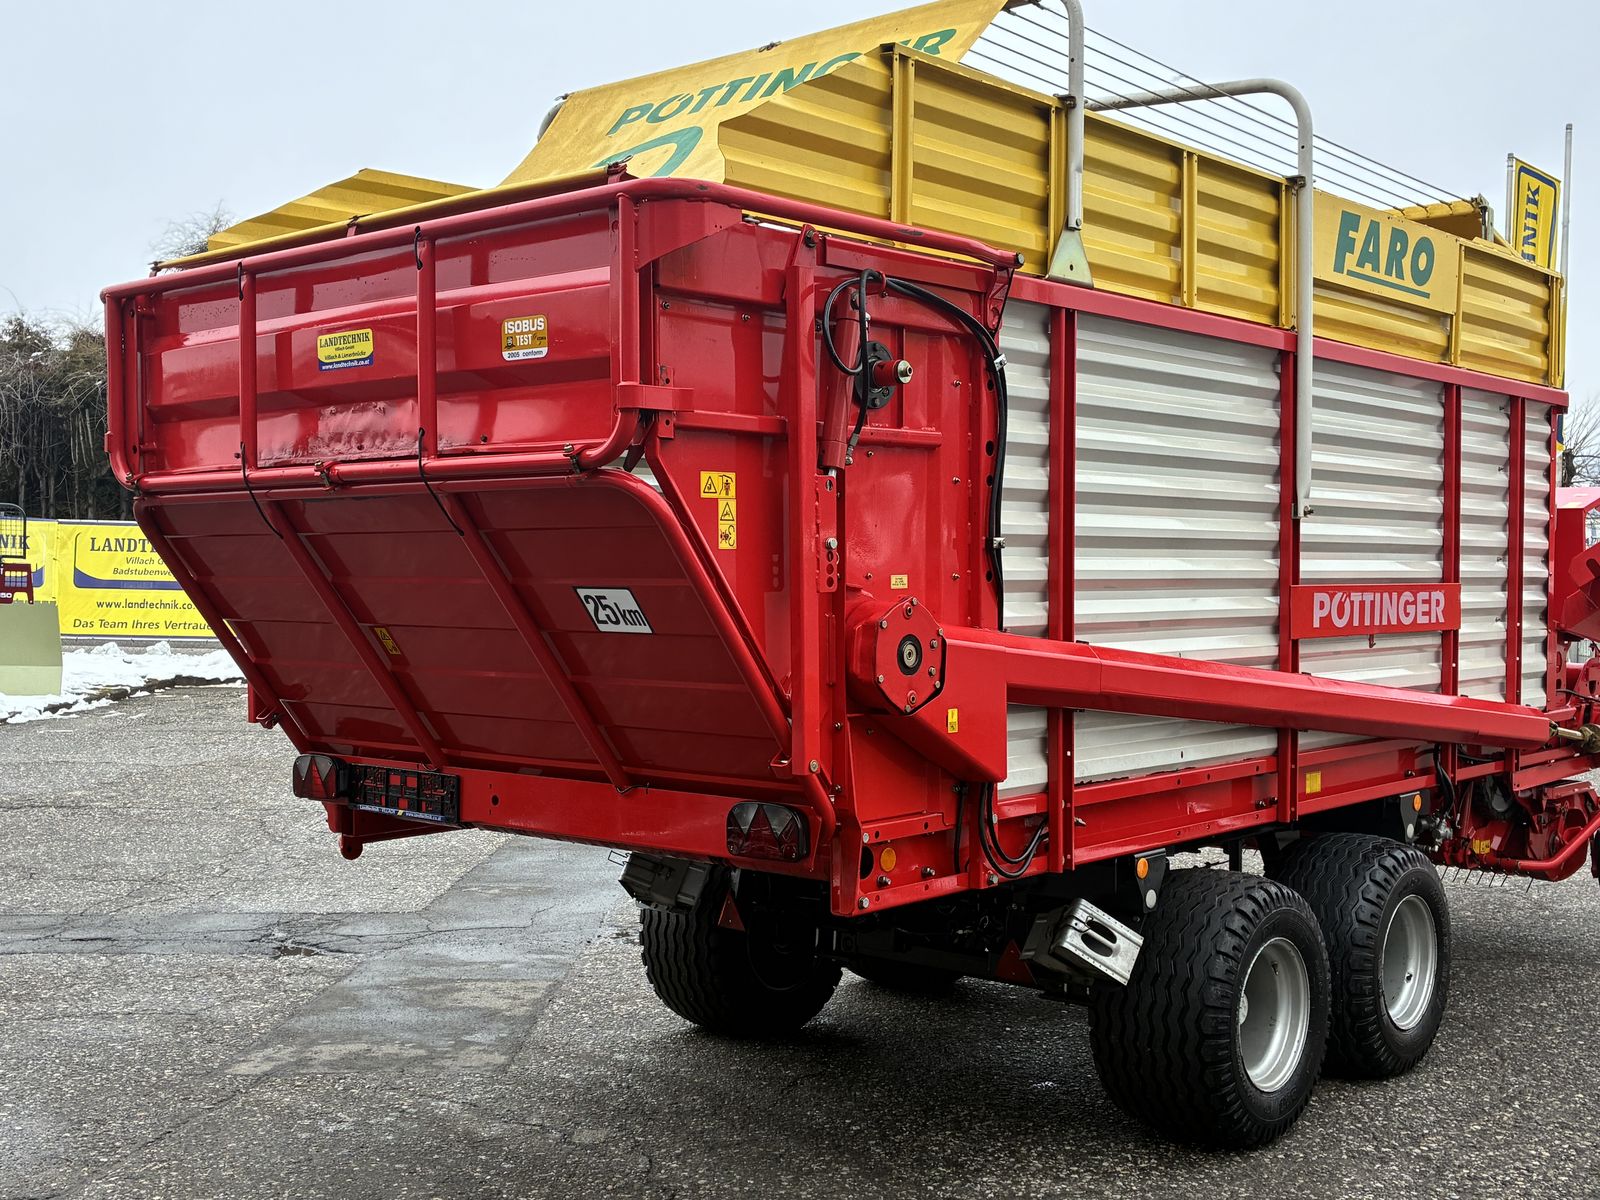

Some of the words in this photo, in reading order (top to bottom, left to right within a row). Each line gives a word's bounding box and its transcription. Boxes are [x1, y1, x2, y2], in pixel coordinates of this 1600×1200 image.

[1333, 210, 1435, 287] FARO
[504, 317, 545, 334] ISOBUS
[319, 332, 370, 348] LANDTECHNIK
[516, 334, 533, 346] TEST
[322, 360, 370, 370] www.landtechnik.co.at
[126, 557, 154, 565] Villach
[583, 594, 621, 626] 25
[613, 602, 647, 627] km
[1313, 591, 1445, 628] PÖTTINGER
[73, 619, 94, 628] Das
[99, 619, 128, 629] Team
[132, 619, 160, 630] Ihres
